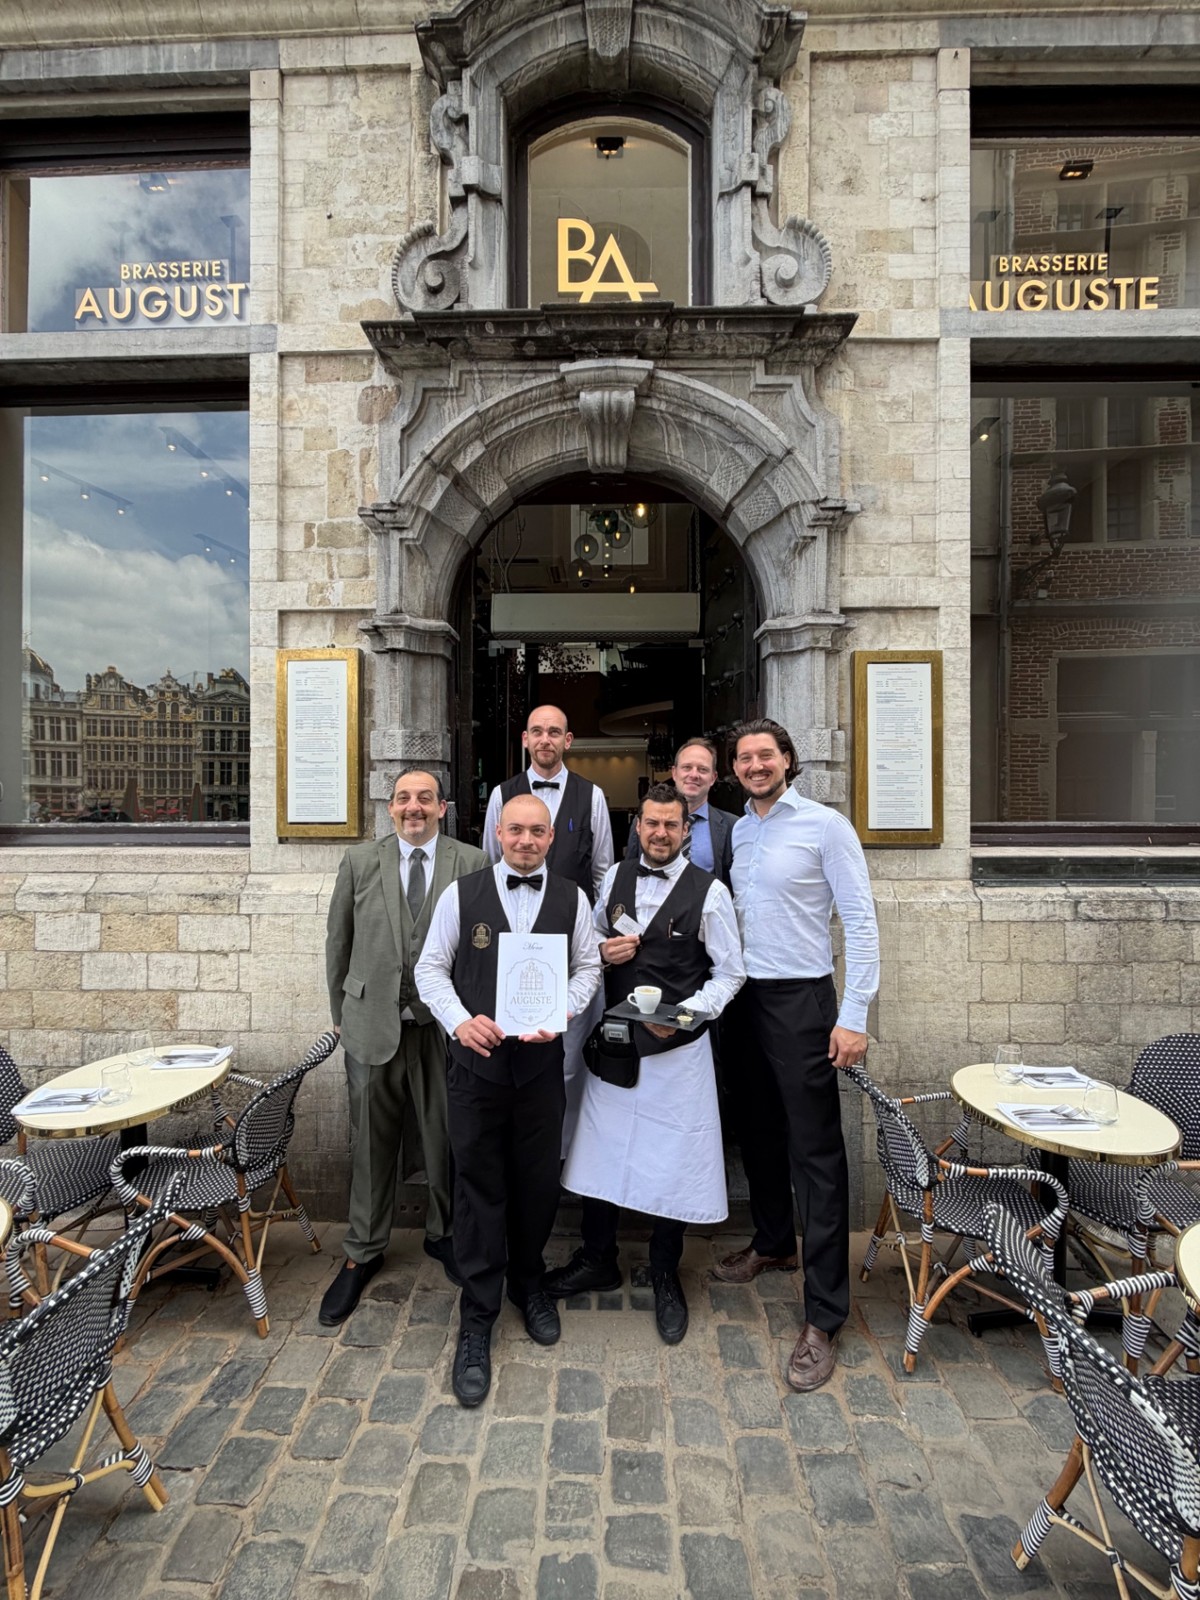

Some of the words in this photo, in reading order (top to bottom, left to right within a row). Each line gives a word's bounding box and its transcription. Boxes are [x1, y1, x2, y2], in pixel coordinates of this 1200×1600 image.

[120, 260, 221, 280] BRASSERIE
[558, 218, 659, 303] BA
[999, 253, 1108, 273] BRASSERIE
[510, 995, 552, 1005] AUGUSTE
